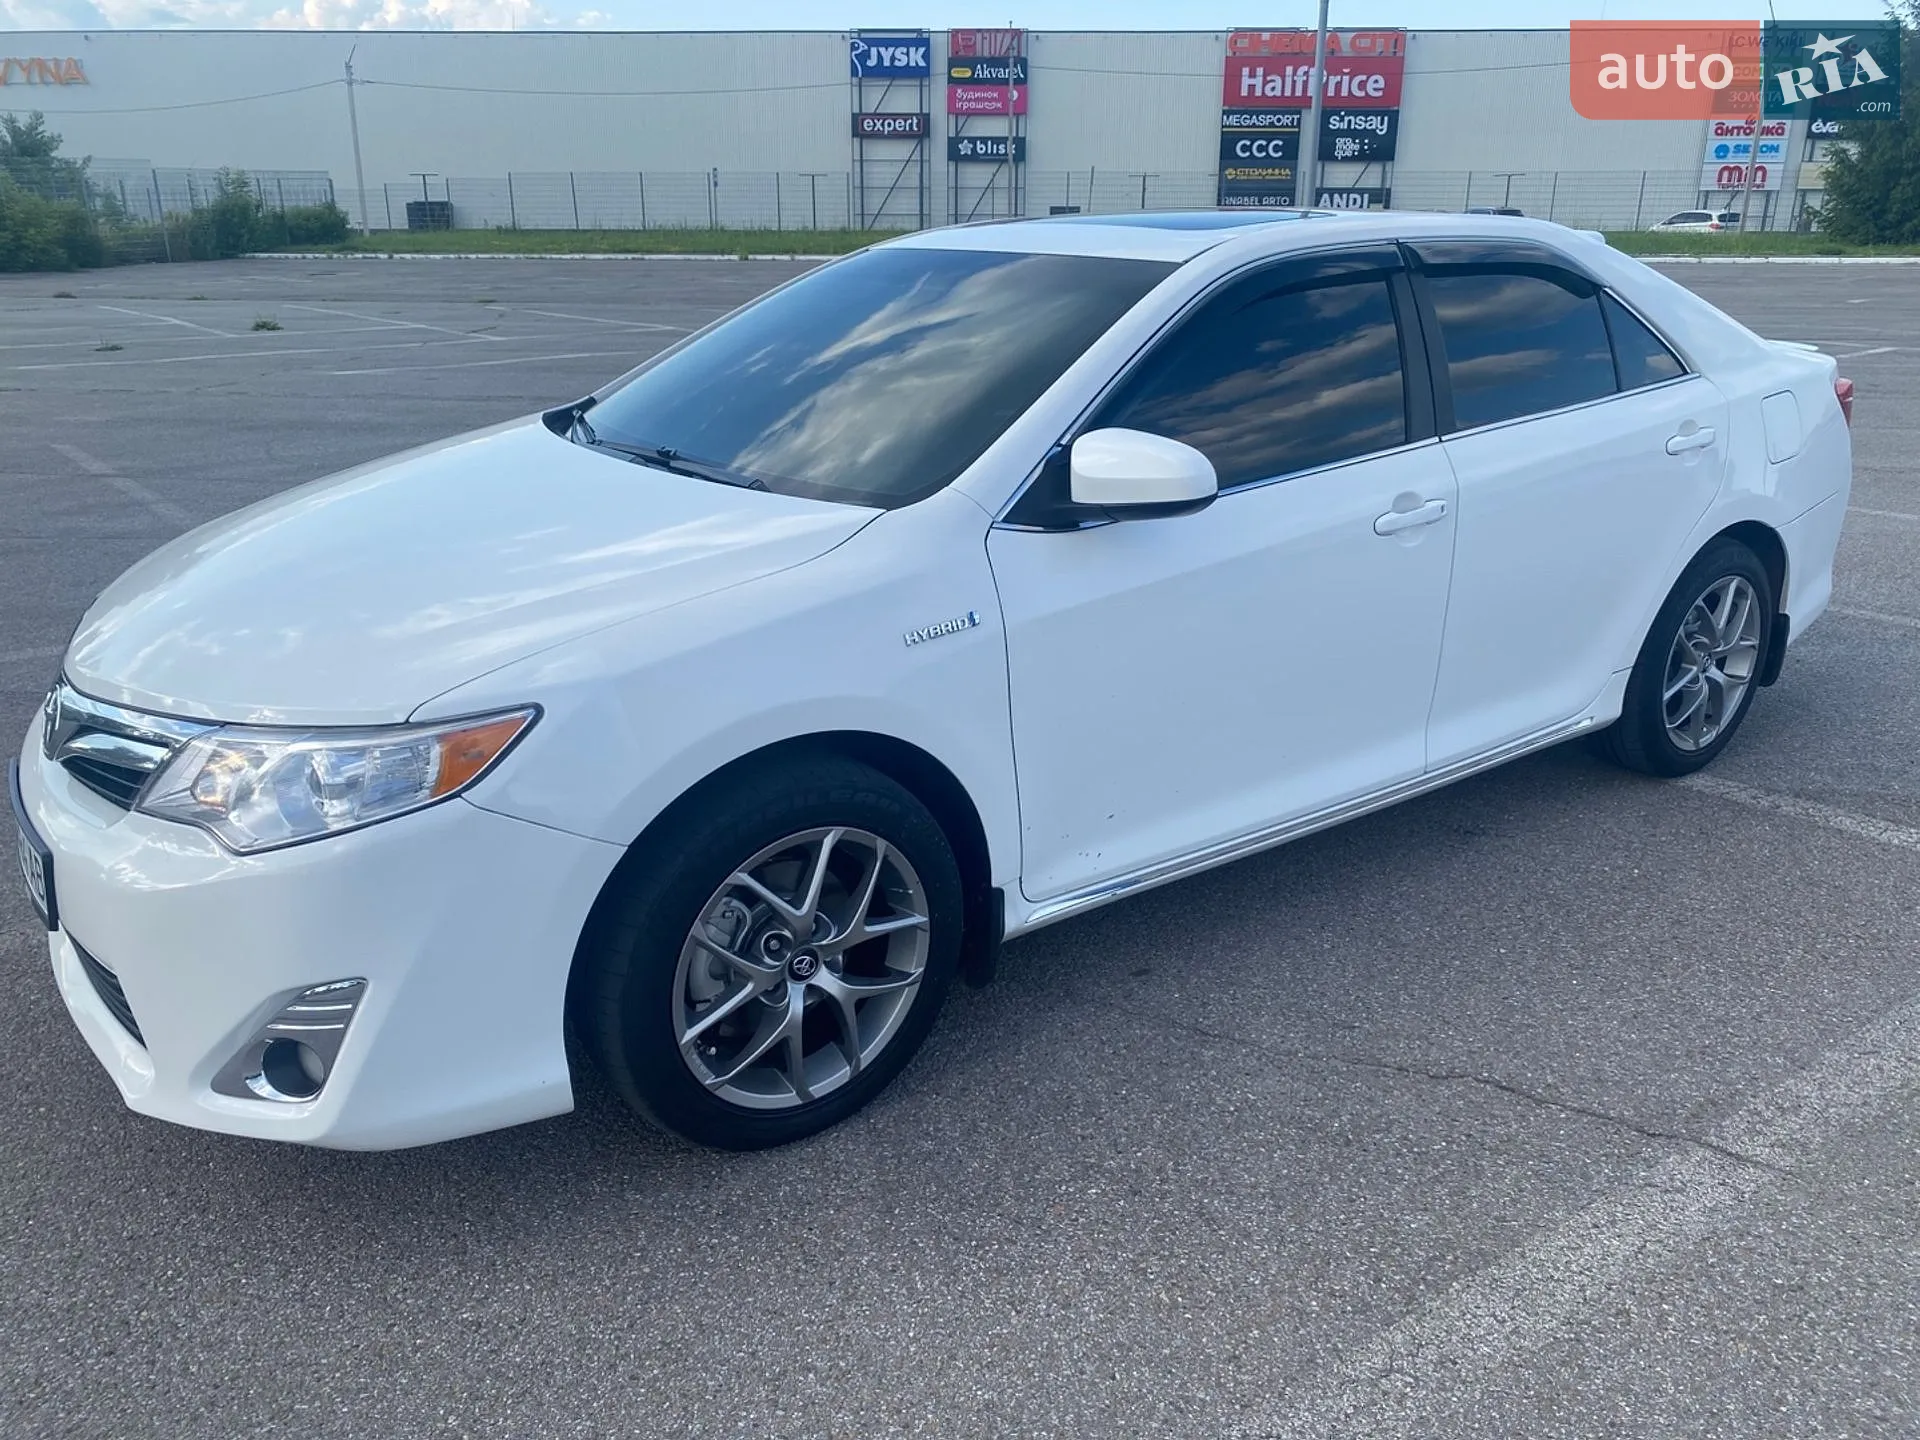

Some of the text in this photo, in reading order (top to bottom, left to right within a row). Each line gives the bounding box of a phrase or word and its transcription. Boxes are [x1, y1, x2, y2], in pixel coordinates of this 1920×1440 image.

[866, 47, 927, 67] JYSK
[974, 64, 1025, 79] Akvarel
[1240, 66, 1386, 98] HalfPrice
[956, 89, 999, 99] будинок
[863, 116, 919, 134] expert
[1222, 114, 1300, 127] MEGASPORT
[1328, 111, 1389, 135] sinsay
[976, 140, 1016, 155] blisk
[1235, 140, 1284, 158] CCC
[1731, 144, 1780, 154] SEON
[902, 616, 969, 647] HYBRID
